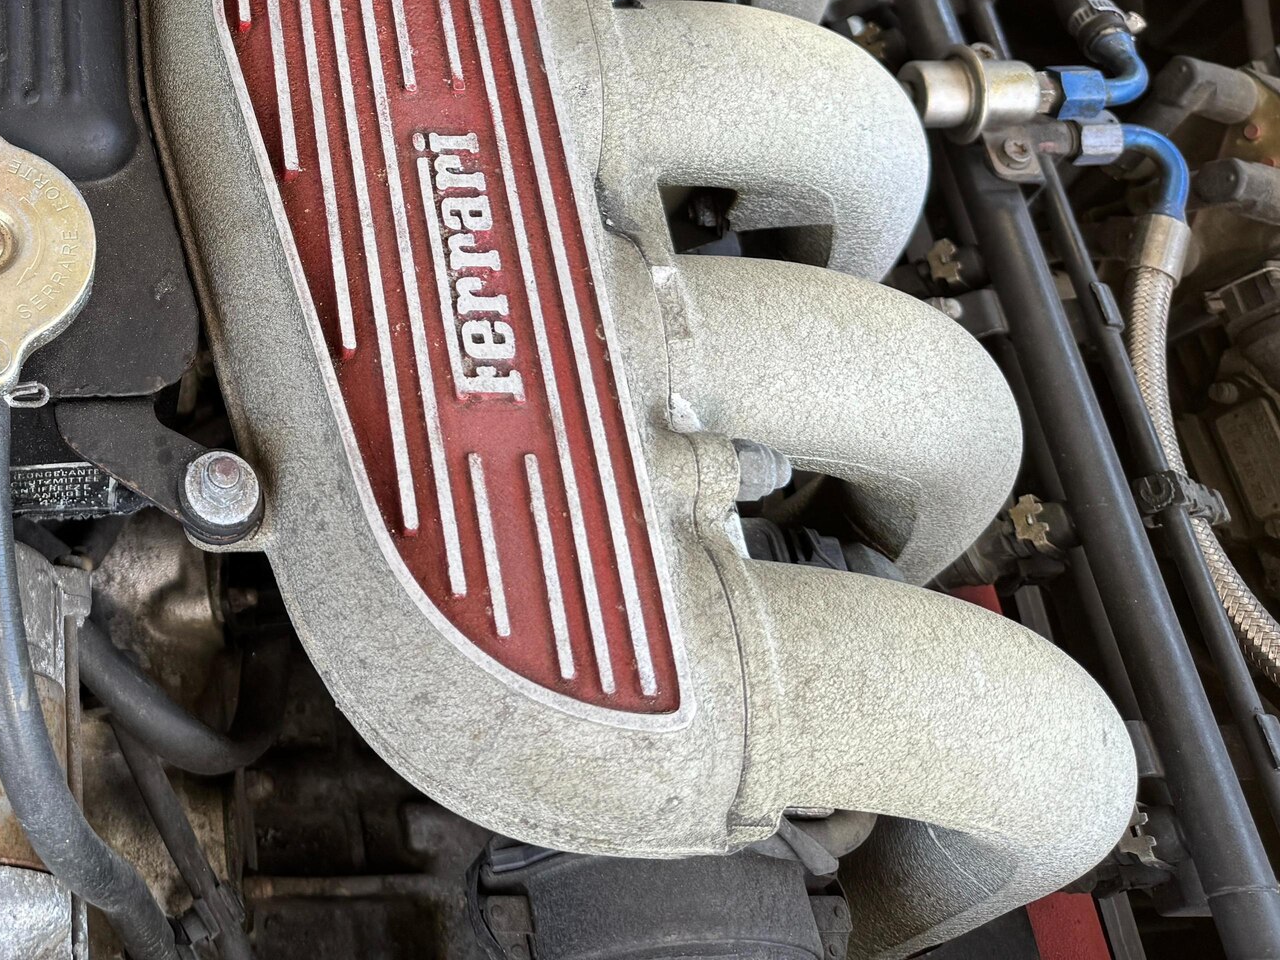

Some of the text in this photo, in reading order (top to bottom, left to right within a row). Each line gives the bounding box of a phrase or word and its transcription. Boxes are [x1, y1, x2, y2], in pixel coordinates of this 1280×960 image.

[7, 158, 80, 320] SERRARE FORTE
[412, 131, 526, 403] Ferrari
